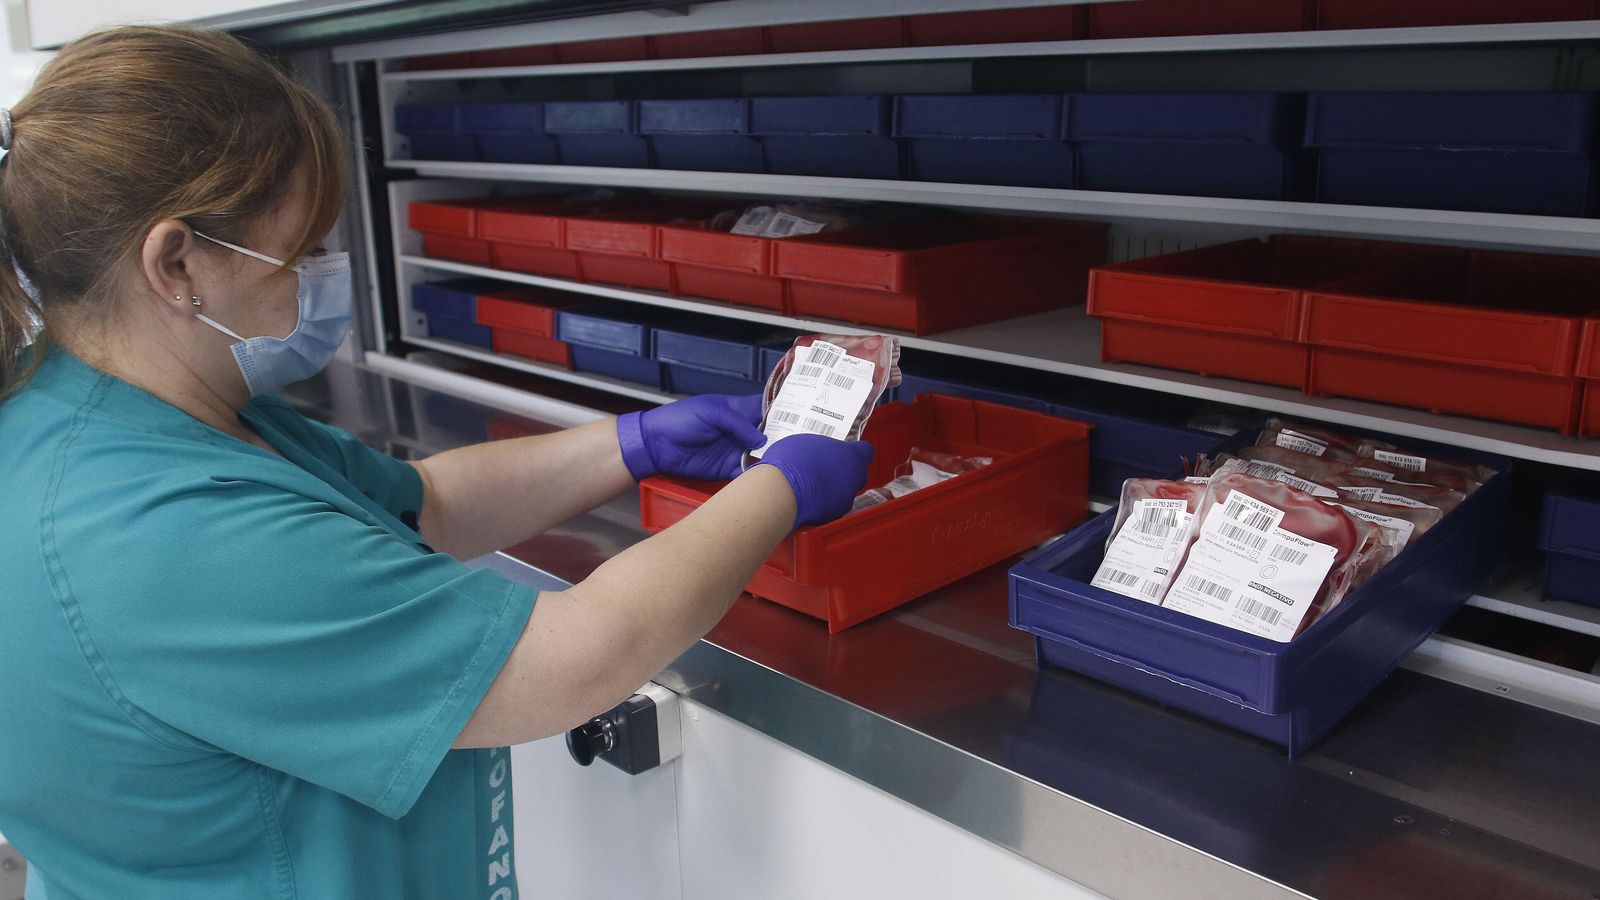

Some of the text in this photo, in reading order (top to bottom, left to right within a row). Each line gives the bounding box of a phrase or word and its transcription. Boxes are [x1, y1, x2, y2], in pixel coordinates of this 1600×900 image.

[816, 389, 830, 405] A
[1379, 495, 1417, 506] ompoFlow®
[1263, 587, 1294, 605] NEGATIVO
[487, 746, 513, 900] OFAN
